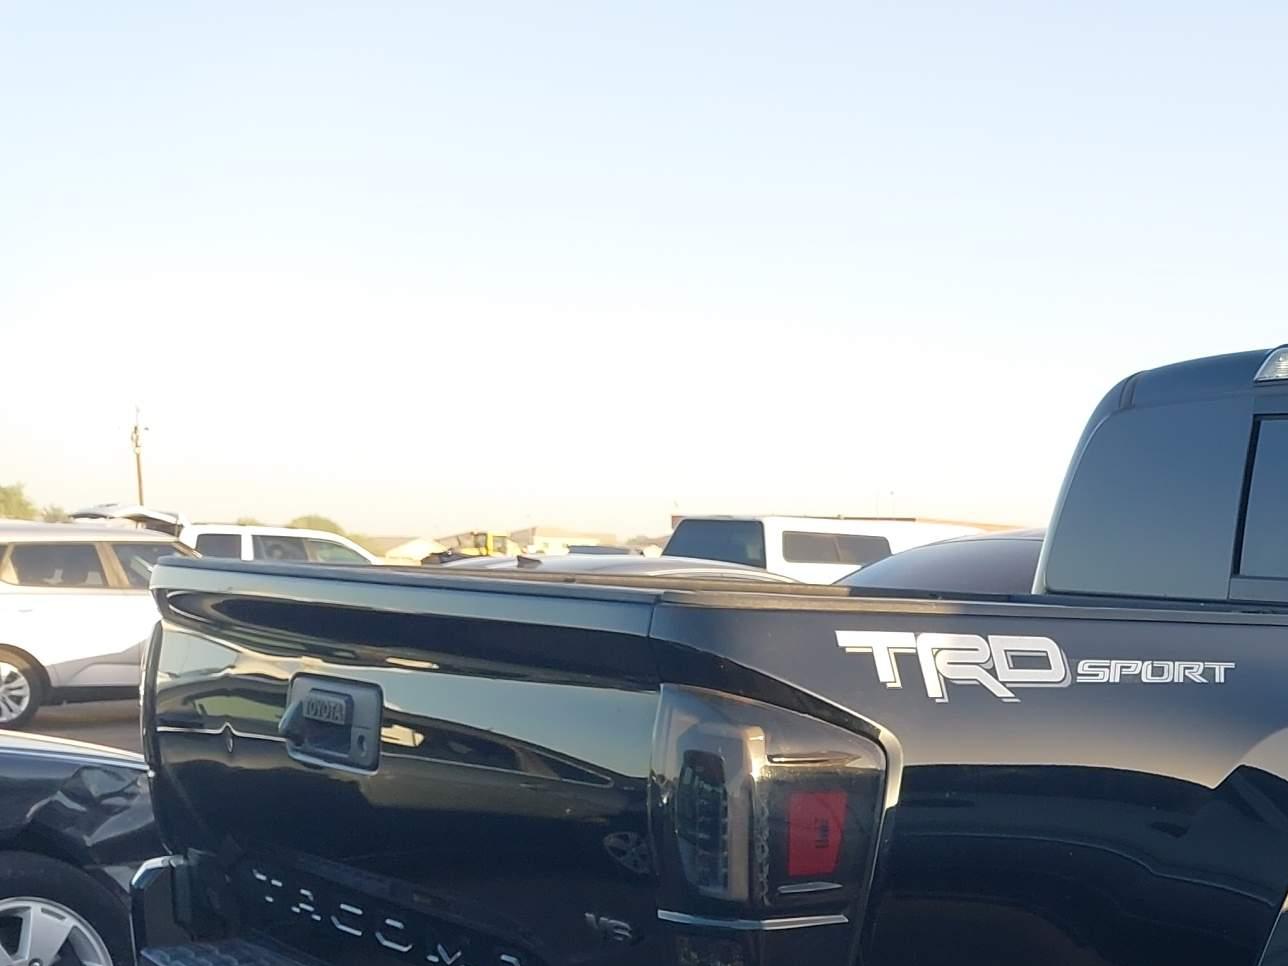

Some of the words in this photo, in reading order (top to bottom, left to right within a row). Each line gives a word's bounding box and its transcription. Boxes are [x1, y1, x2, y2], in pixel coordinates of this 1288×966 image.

[835, 630, 1071, 702] TRD
[1076, 659, 1236, 684] SPORT
[304, 699, 346, 721] TOYOTA
